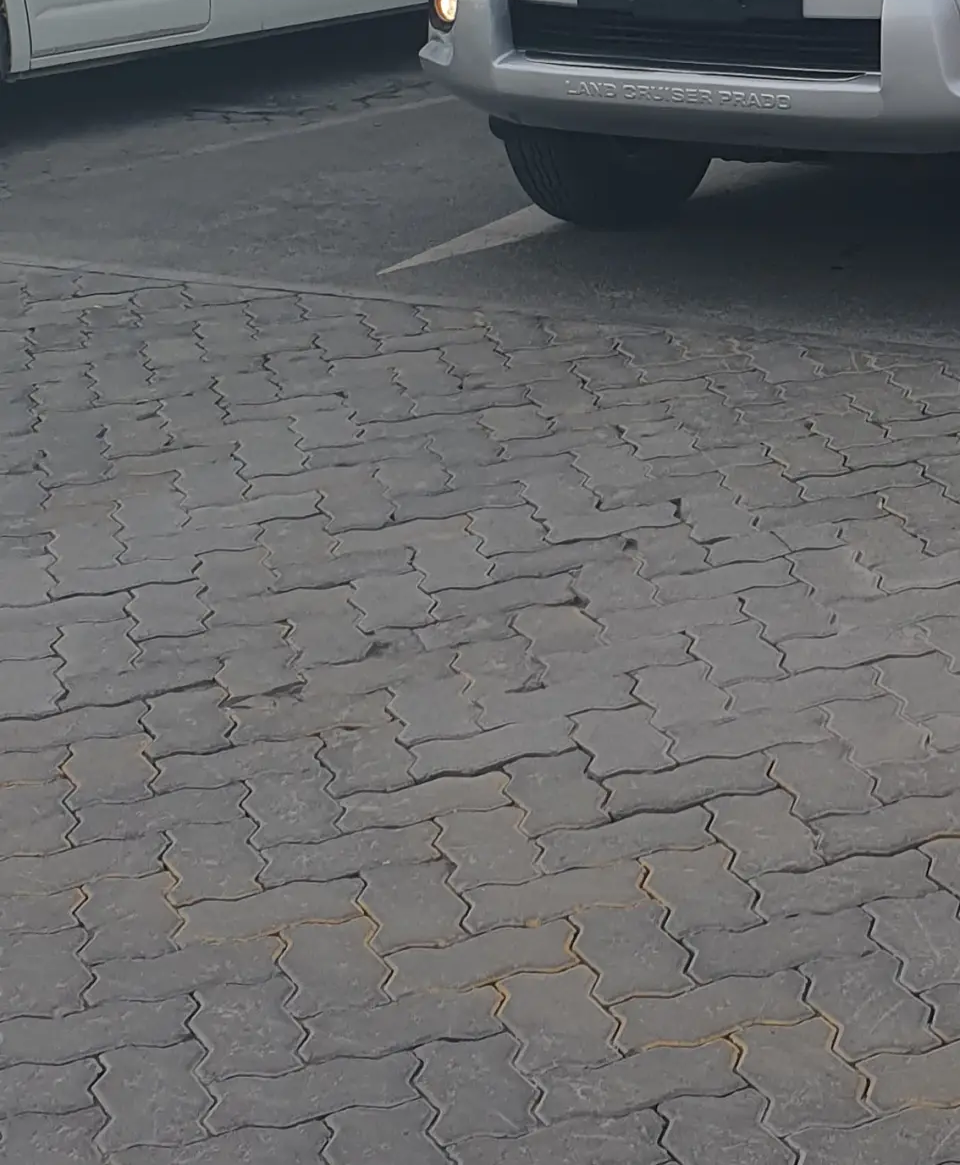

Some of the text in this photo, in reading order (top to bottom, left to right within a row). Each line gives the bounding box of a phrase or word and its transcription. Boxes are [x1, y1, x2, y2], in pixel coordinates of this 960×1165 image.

[565, 80, 792, 110] LAND CRUISER PRADO
